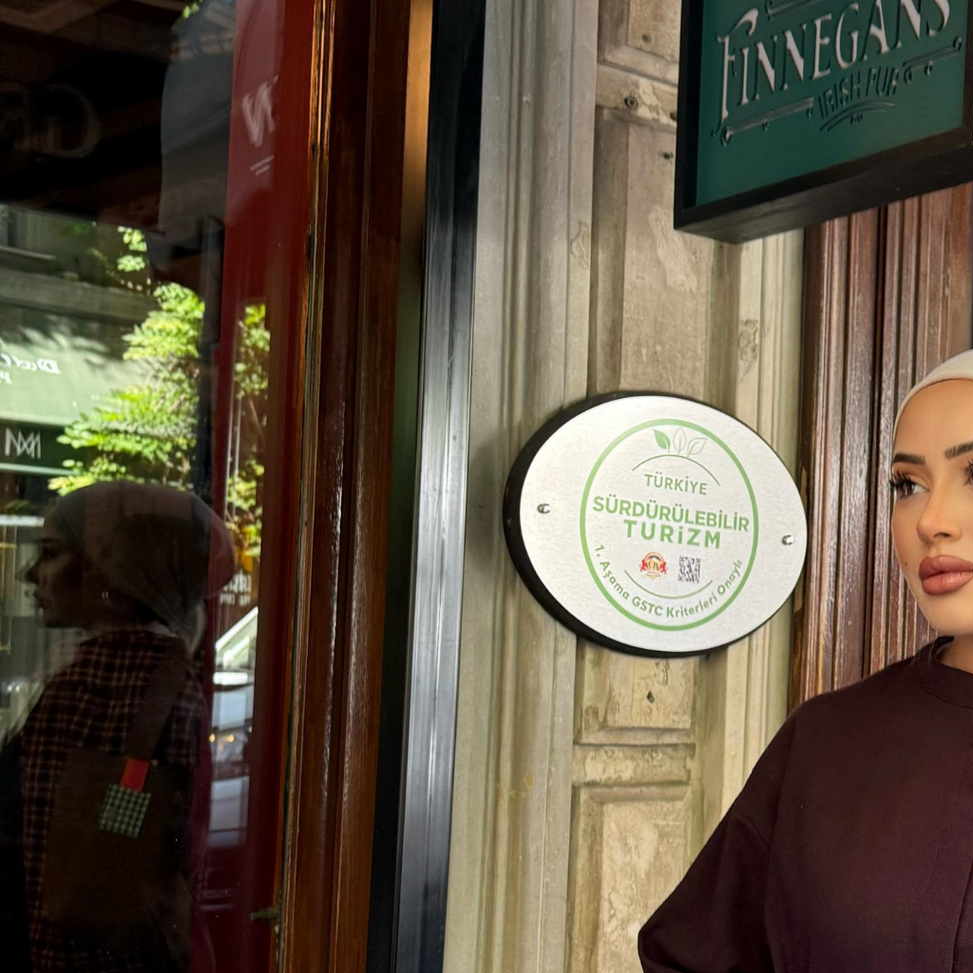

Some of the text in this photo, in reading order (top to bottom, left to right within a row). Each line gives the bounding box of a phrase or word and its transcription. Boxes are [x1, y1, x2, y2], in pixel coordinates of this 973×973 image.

[711, 0, 951, 137] FINNEGANS
[817, 66, 900, 120] IRISH PUB
[644, 471, 708, 496] TÜRKİYE
[592, 494, 750, 532] SÜRDÜRÜLEBİLİR
[600, 561, 630, 600] Aşama
[631, 596, 663, 617] GSTC
[666, 591, 718, 618] Kriterleri
[717, 560, 743, 595] Onaylı
